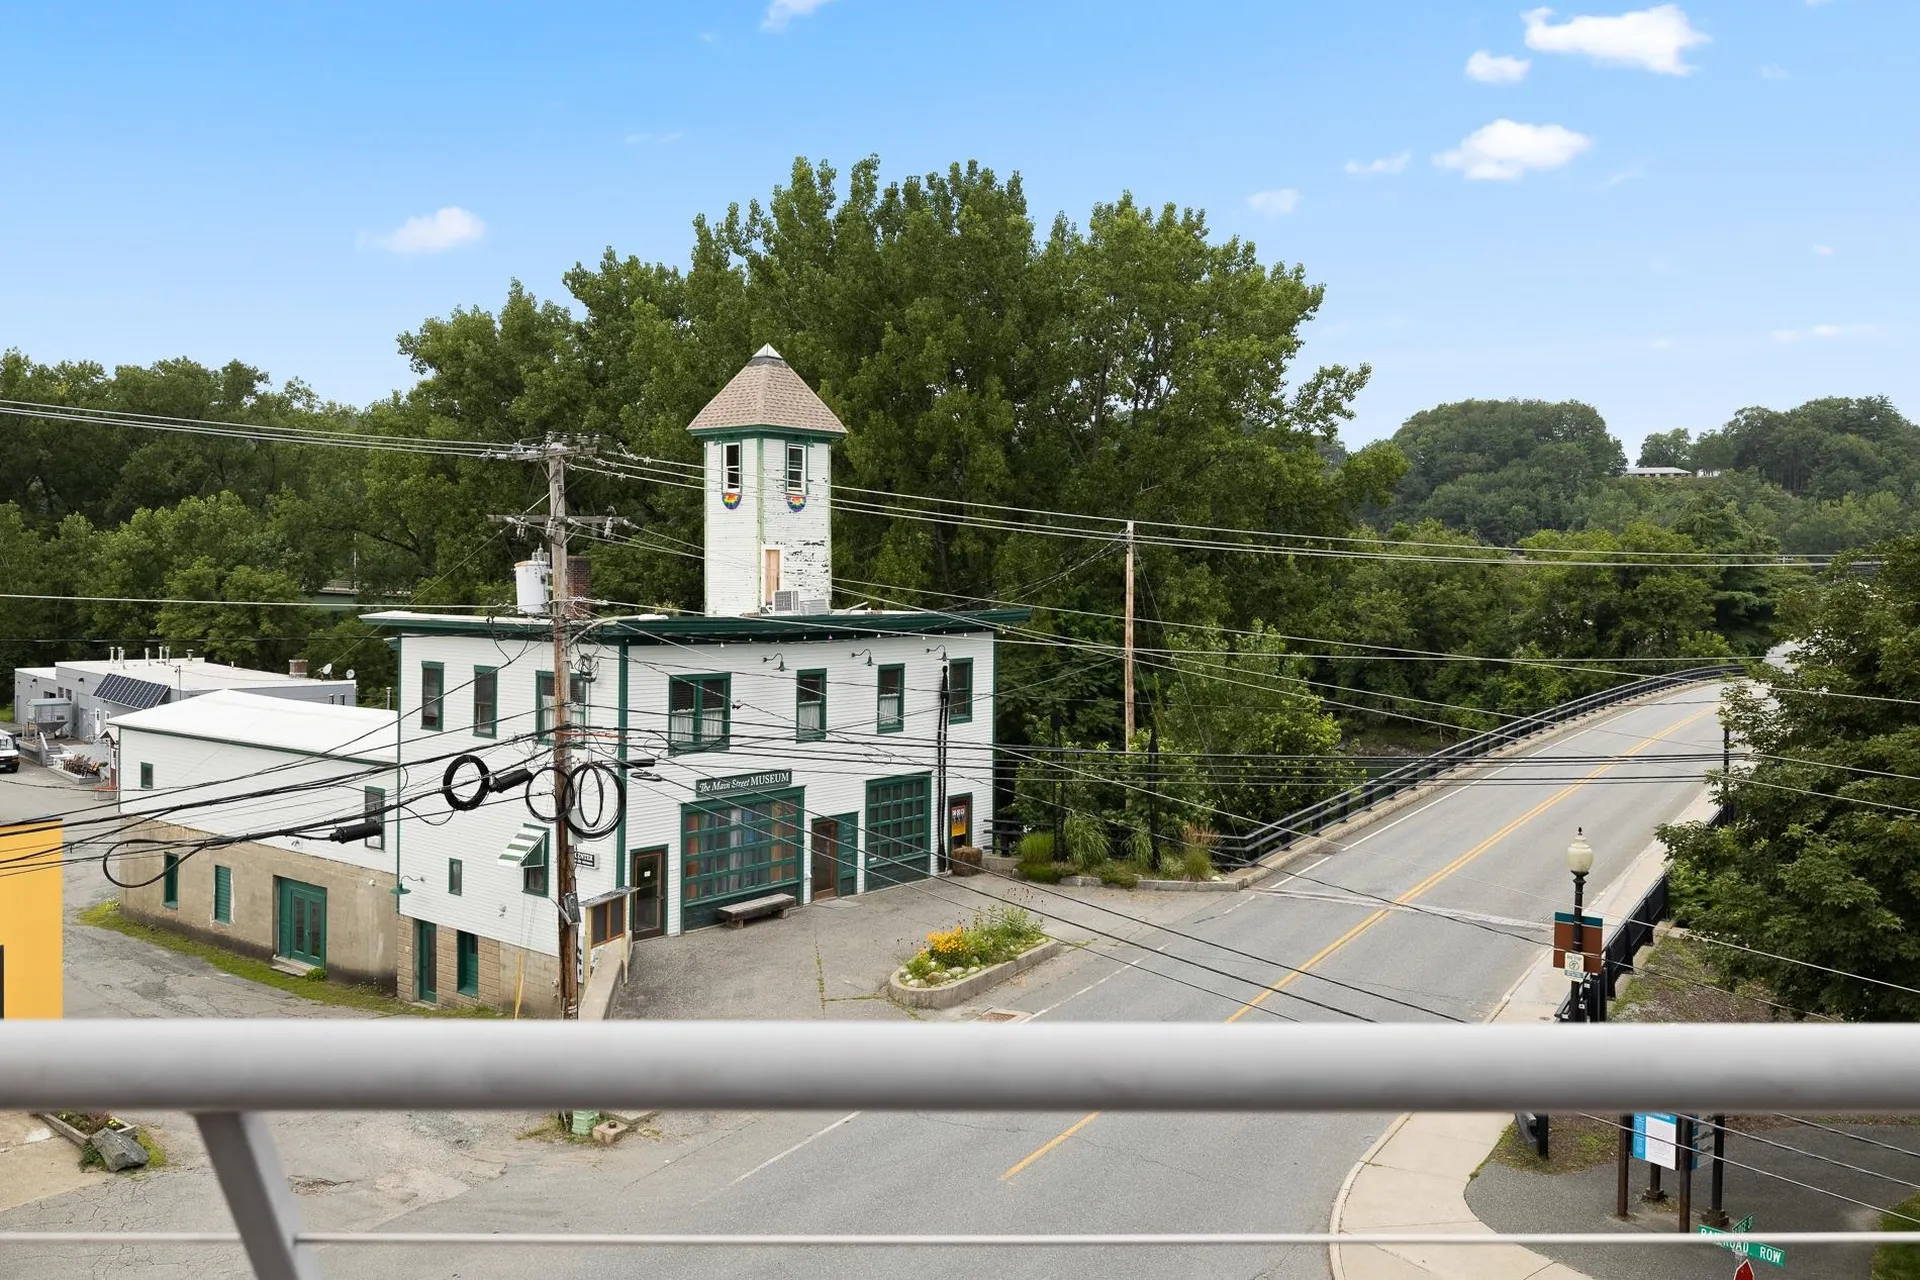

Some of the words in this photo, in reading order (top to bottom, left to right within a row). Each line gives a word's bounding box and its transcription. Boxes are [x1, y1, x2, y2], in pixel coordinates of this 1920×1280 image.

[699, 782, 711, 793] The
[711, 780, 731, 791] Main
[731, 778, 750, 789] Street
[750, 772, 789, 786] MUSEUM
[1700, 1228, 1749, 1253] RAROAD
[1759, 1246, 1782, 1264] ROW
